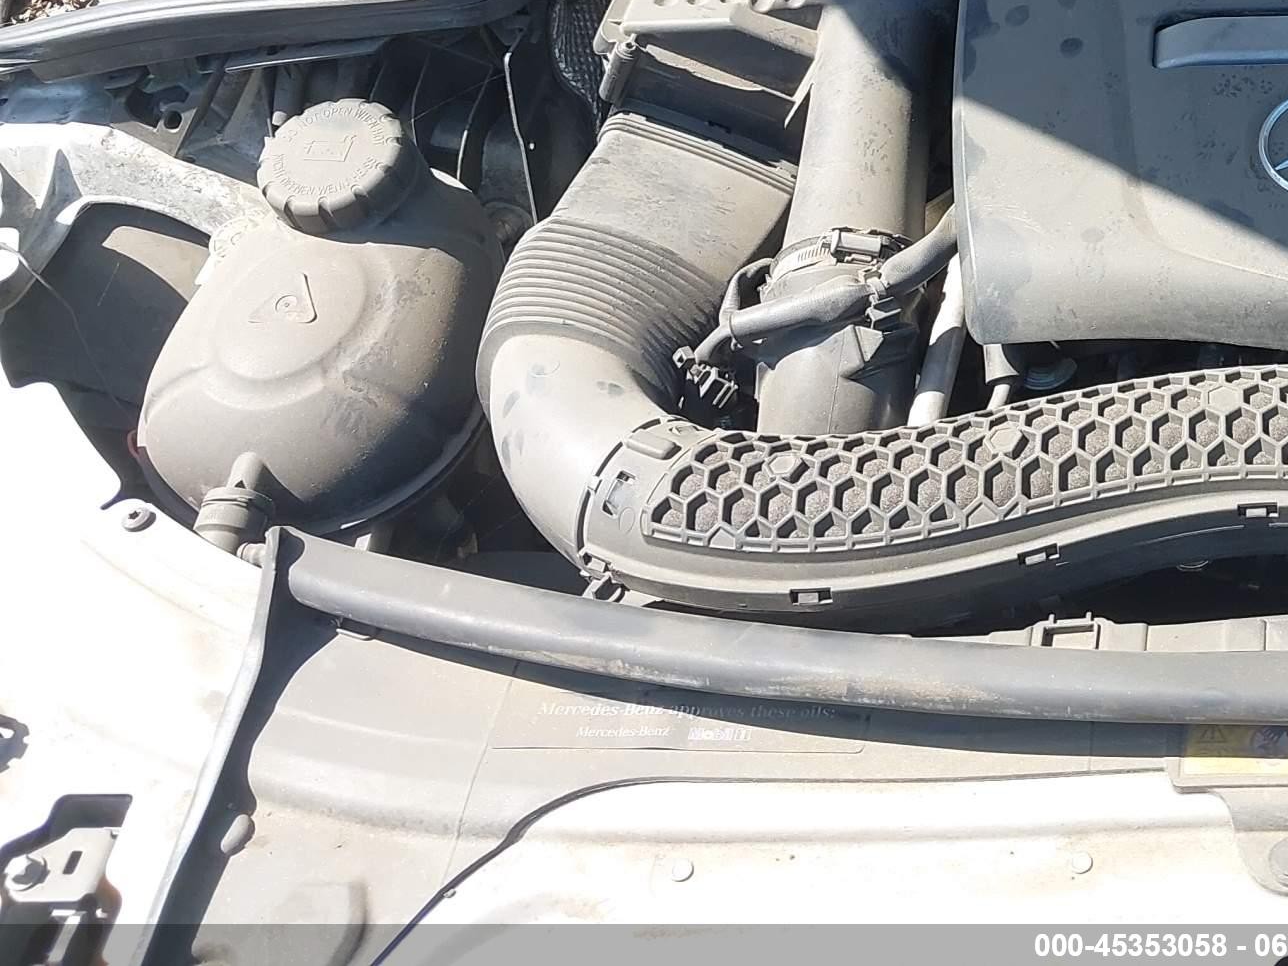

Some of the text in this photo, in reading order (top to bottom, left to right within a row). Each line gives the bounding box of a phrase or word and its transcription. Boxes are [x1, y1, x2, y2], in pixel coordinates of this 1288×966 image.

[322, 106, 354, 120] OPEN
[538, 702, 664, 716] Mercedes-Benz
[750, 704, 796, 719] these
[575, 725, 671, 738] Mercedes-Benz
